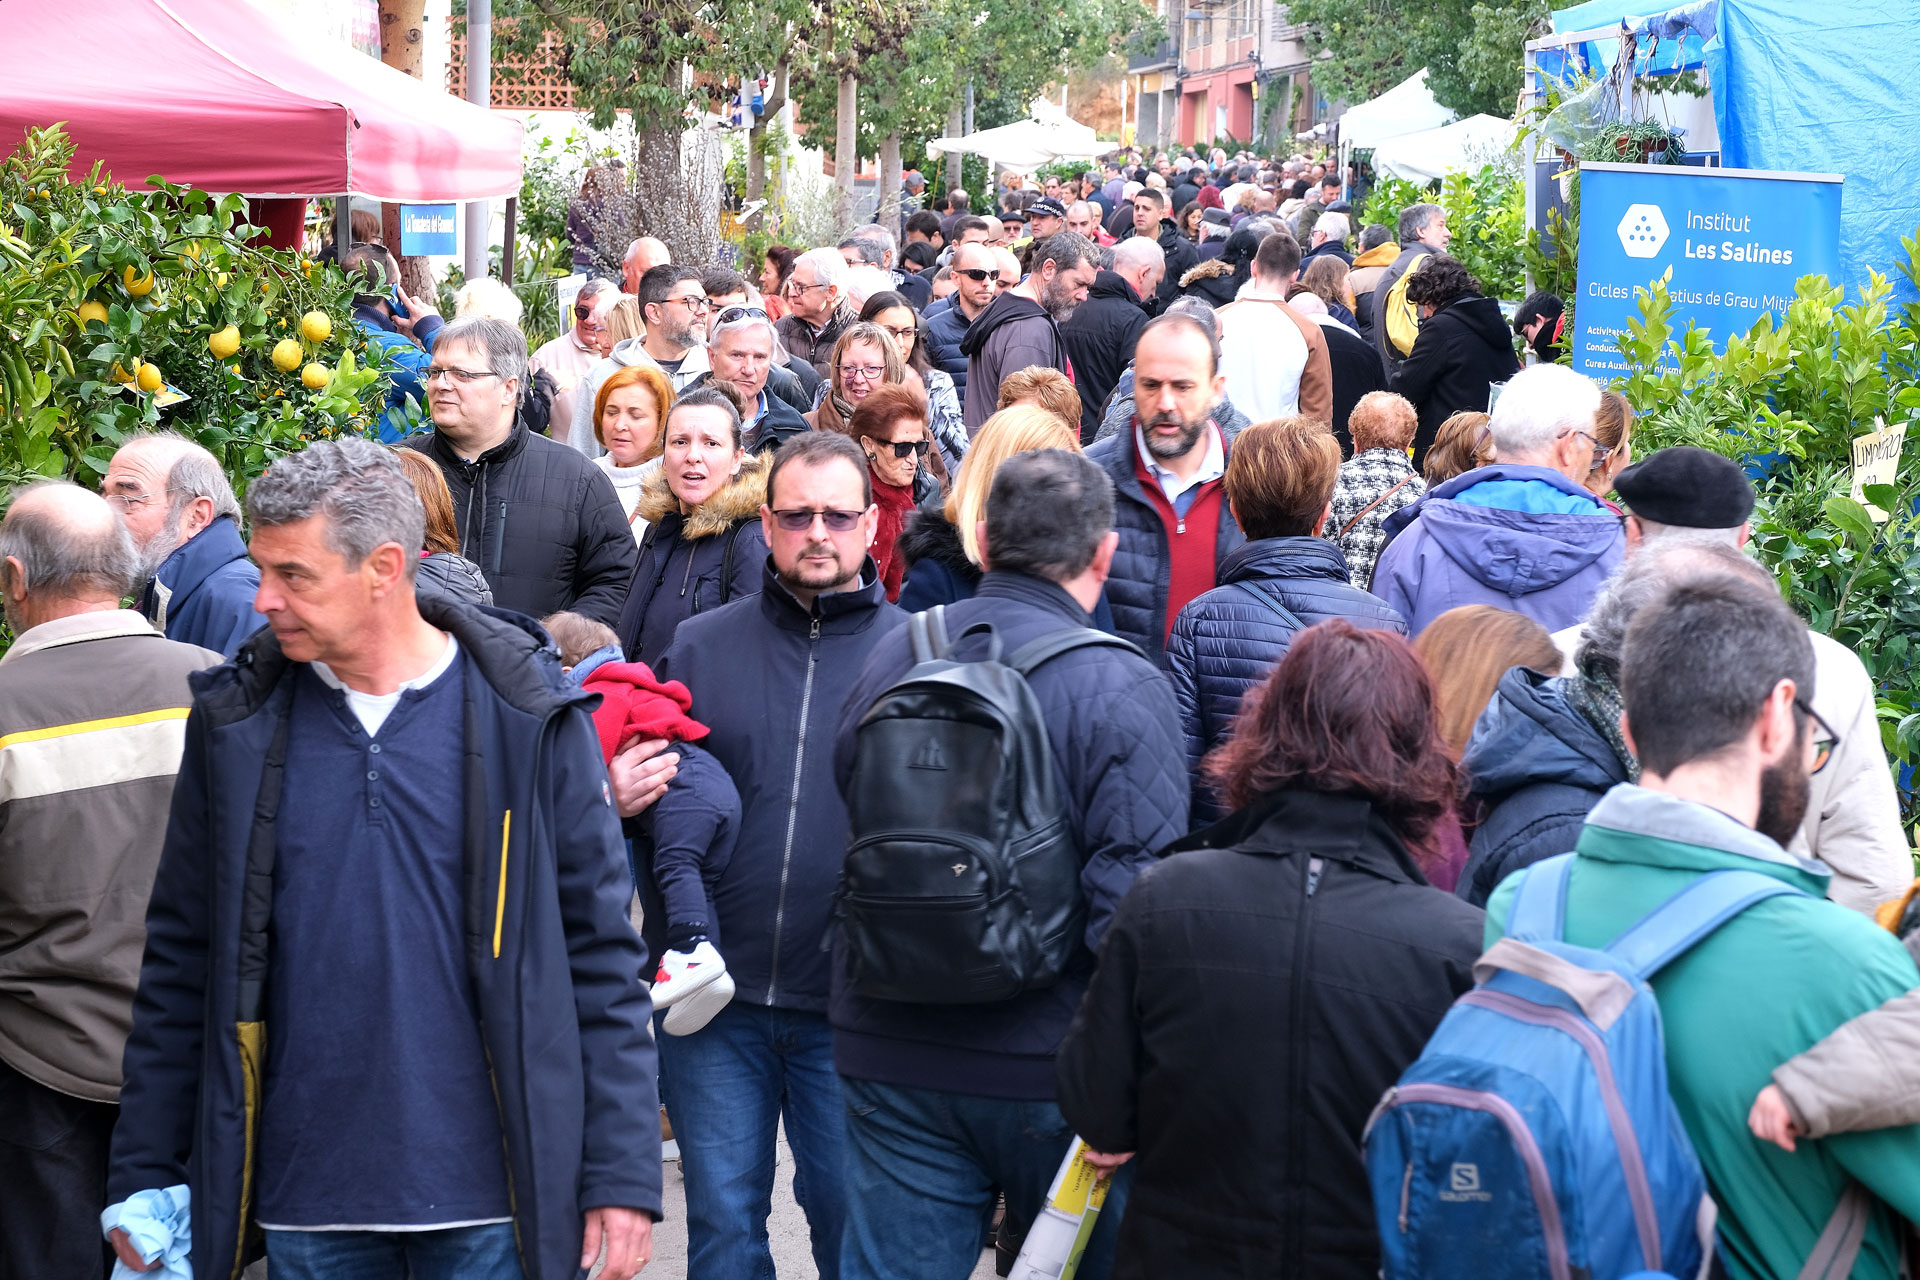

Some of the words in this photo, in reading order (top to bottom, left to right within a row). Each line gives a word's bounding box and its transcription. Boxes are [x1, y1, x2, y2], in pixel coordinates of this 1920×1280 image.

[1686, 209, 1752, 233] Institut
[1684, 238, 1717, 260] Les
[1720, 241, 1793, 265] Salines
[1588, 282, 1628, 299] Cicles
[1705, 290, 1721, 306] de
[1724, 292, 1758, 309] Grau
[1584, 358, 1606, 369] Cures
